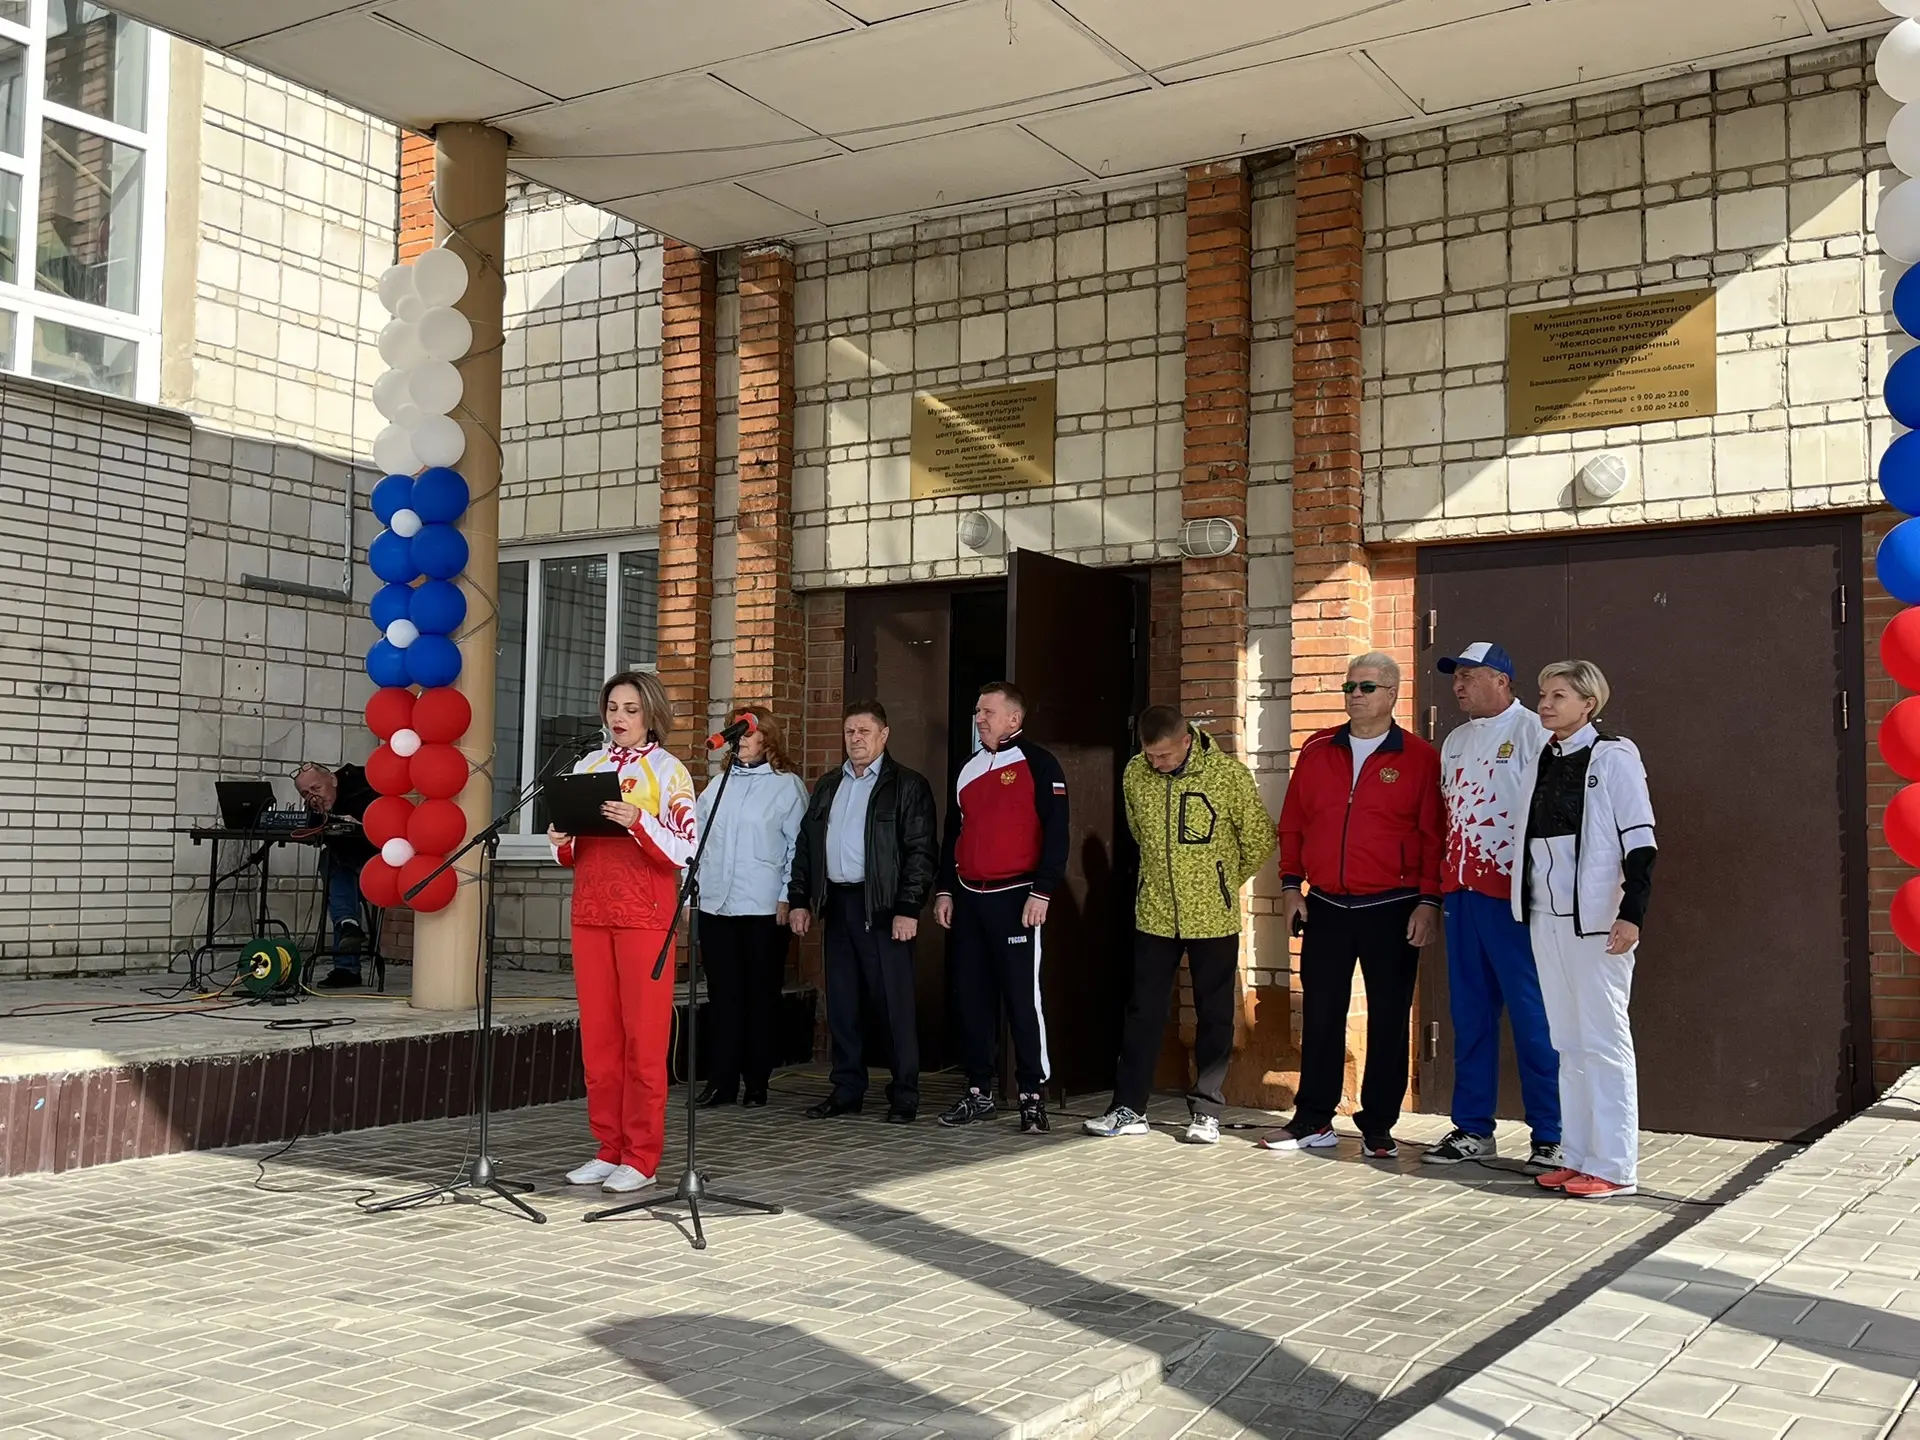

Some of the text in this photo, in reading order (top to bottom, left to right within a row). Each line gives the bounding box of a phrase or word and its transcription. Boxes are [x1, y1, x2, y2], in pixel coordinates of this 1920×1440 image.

[1651, 298, 1675, 307] района
[1534, 304, 1692, 331] Муниципальное бюджетное
[1549, 318, 1673, 341] учреждение культуры
[1554, 329, 1668, 349] "Межпоселенческий
[1543, 338, 1680, 362] центральный районный
[1568, 352, 1653, 371] дом культуры"
[1529, 363, 1695, 387] Башмаковского района Пензенской области
[1609, 385, 1636, 393] работы
[927, 395, 1038, 416] Муниципальное бюджетное
[1534, 402, 1587, 412] Понедельник
[1593, 396, 1627, 405] Пятница
[1637, 392, 1653, 401] 9.00
[1668, 389, 1690, 398] 23.00
[938, 406, 1025, 423] учреждение культуры
[1533, 413, 1566, 424] Суббота
[1572, 408, 1623, 419] Воскресенье
[1637, 403, 1653, 412] 9.00
[1668, 400, 1690, 409] 24.00
[935, 422, 1026, 439] центральная районная
[955, 431, 1005, 444] библиотека"
[935, 440, 1025, 456] Отдел детского чтения
